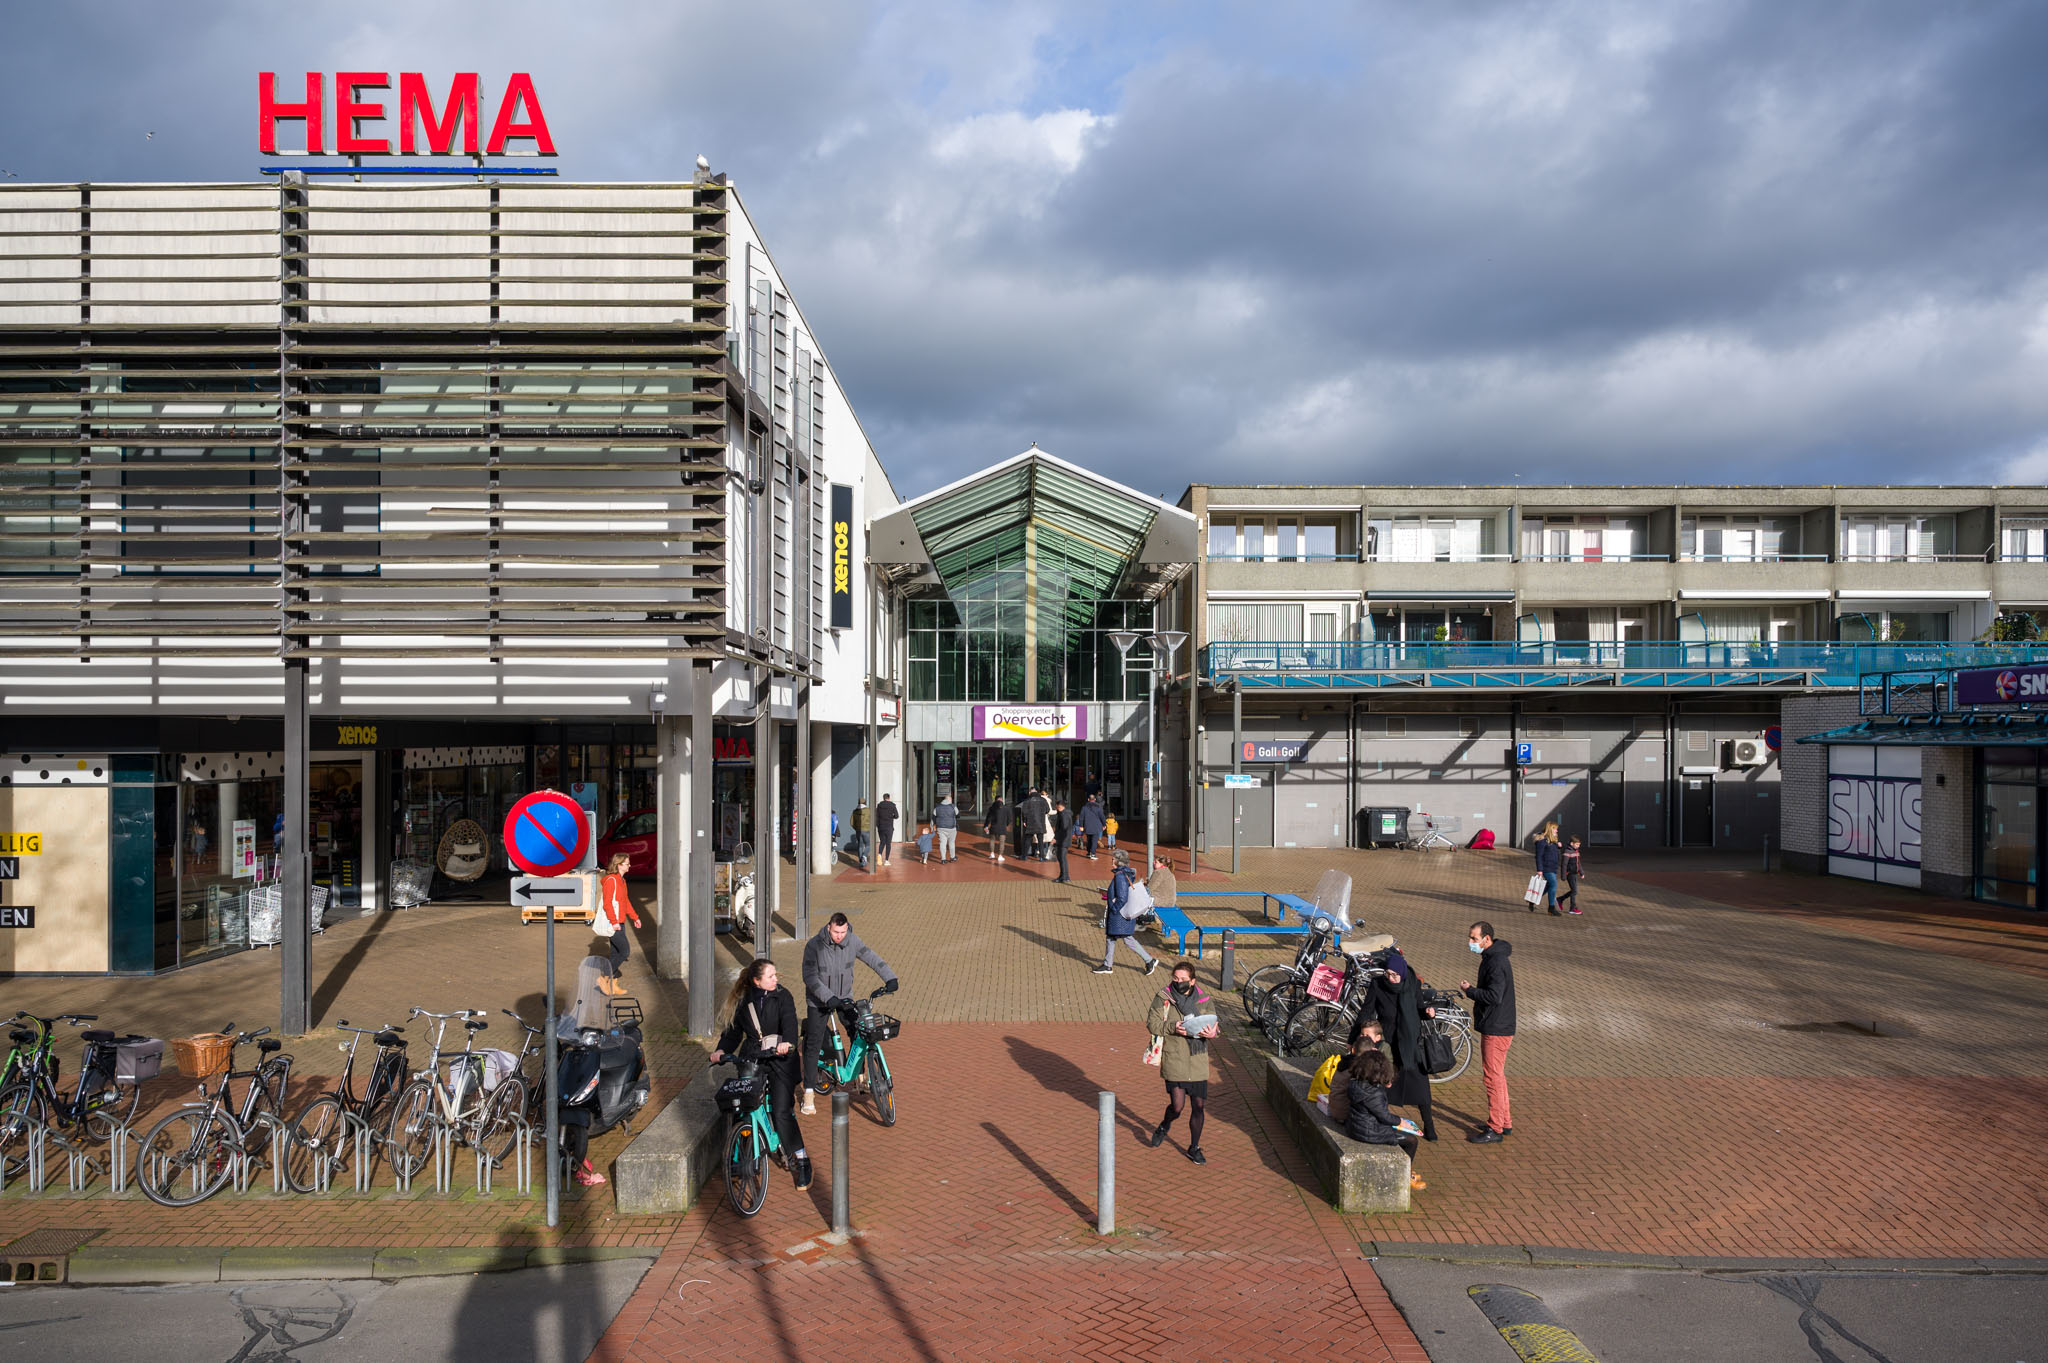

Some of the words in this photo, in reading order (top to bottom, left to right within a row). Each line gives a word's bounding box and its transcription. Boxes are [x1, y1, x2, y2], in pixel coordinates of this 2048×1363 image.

[258, 71, 558, 156] HEMA
[834, 520, 849, 595] xenos
[2020, 673, 2048, 696] SN
[992, 713, 1066, 726] Overvecht
[1001, 707, 1052, 716] Shoppingcenter
[337, 726, 378, 745] xenos
[1520, 744, 1529, 756] P
